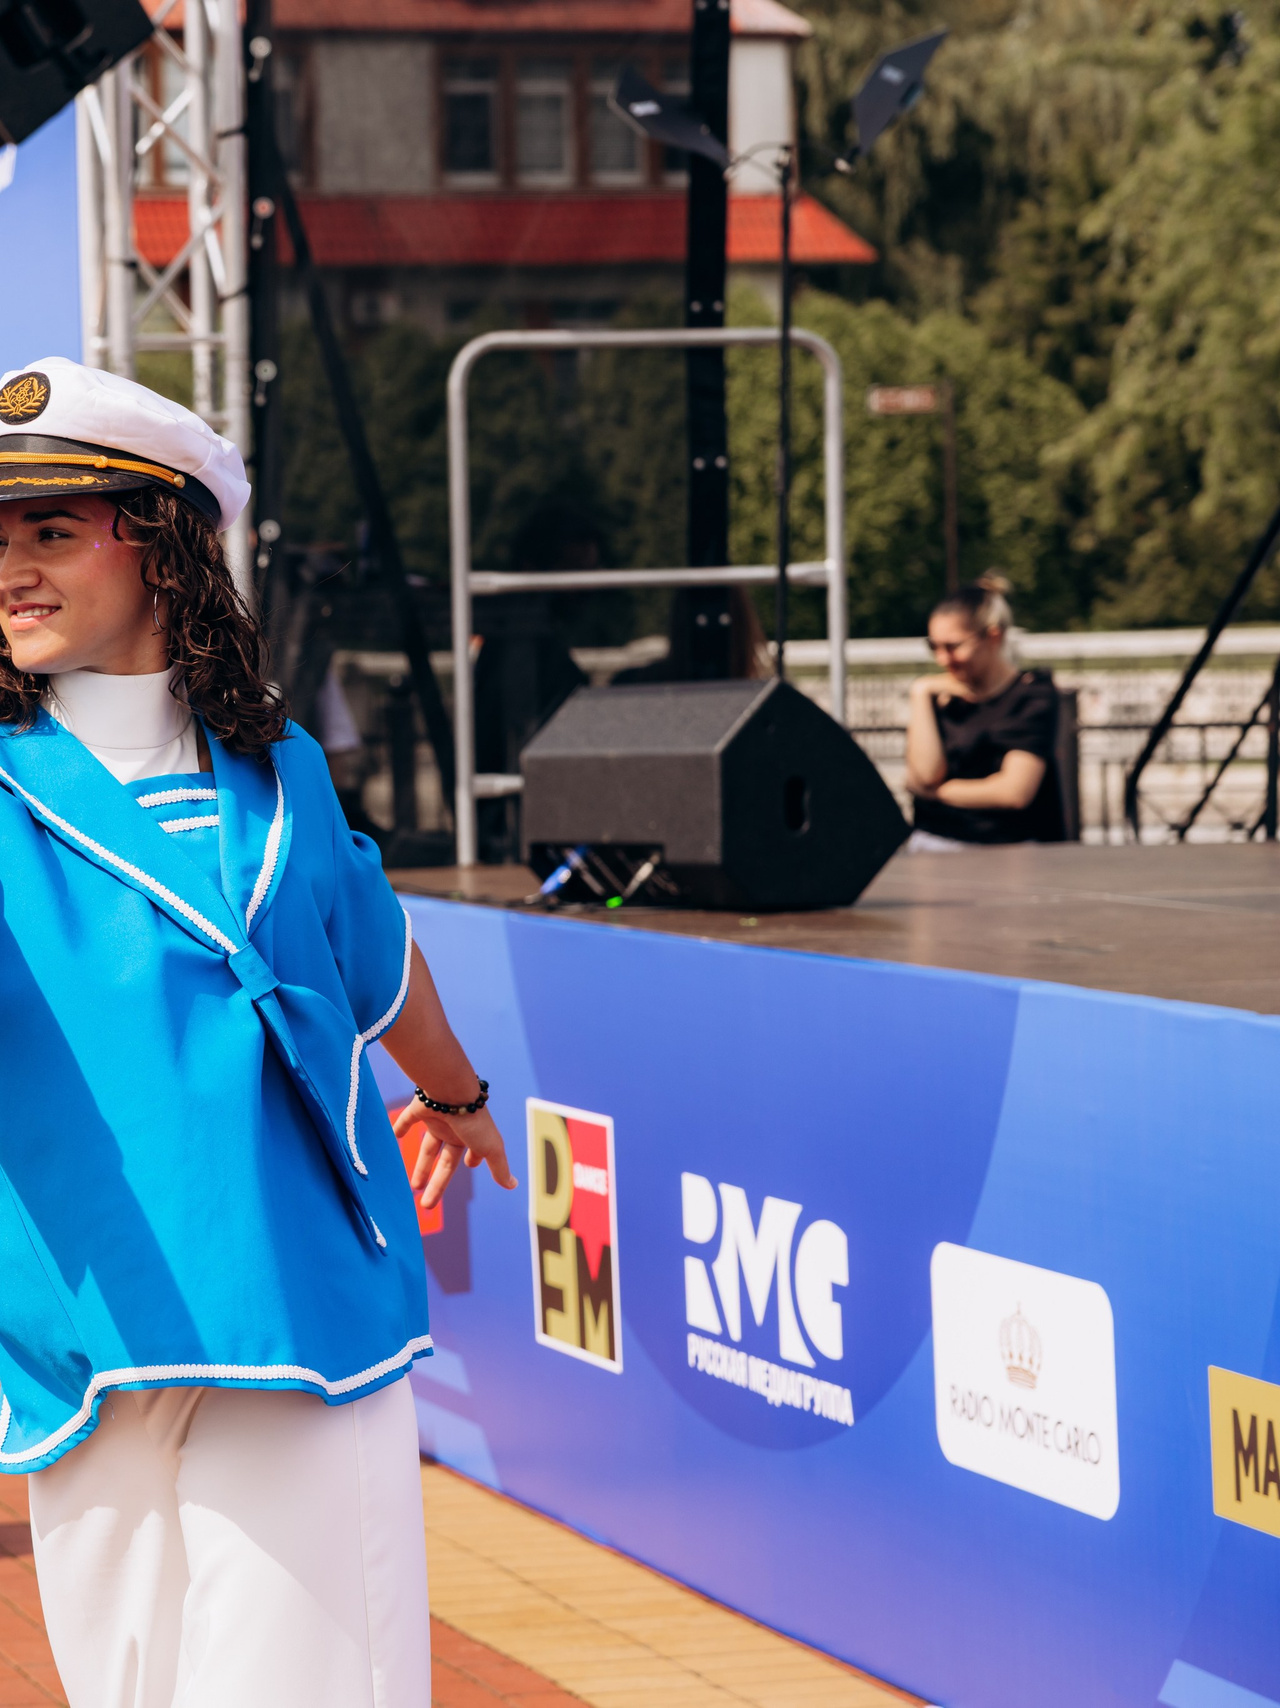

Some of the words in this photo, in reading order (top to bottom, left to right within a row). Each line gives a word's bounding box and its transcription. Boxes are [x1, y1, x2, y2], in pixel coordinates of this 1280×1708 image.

[687, 1333, 748, 1388] РУССКАЯ
[950, 1383, 995, 1428] RADIO
[998, 1402, 1051, 1450] MONTE
[1053, 1419, 1101, 1466] CARLO
